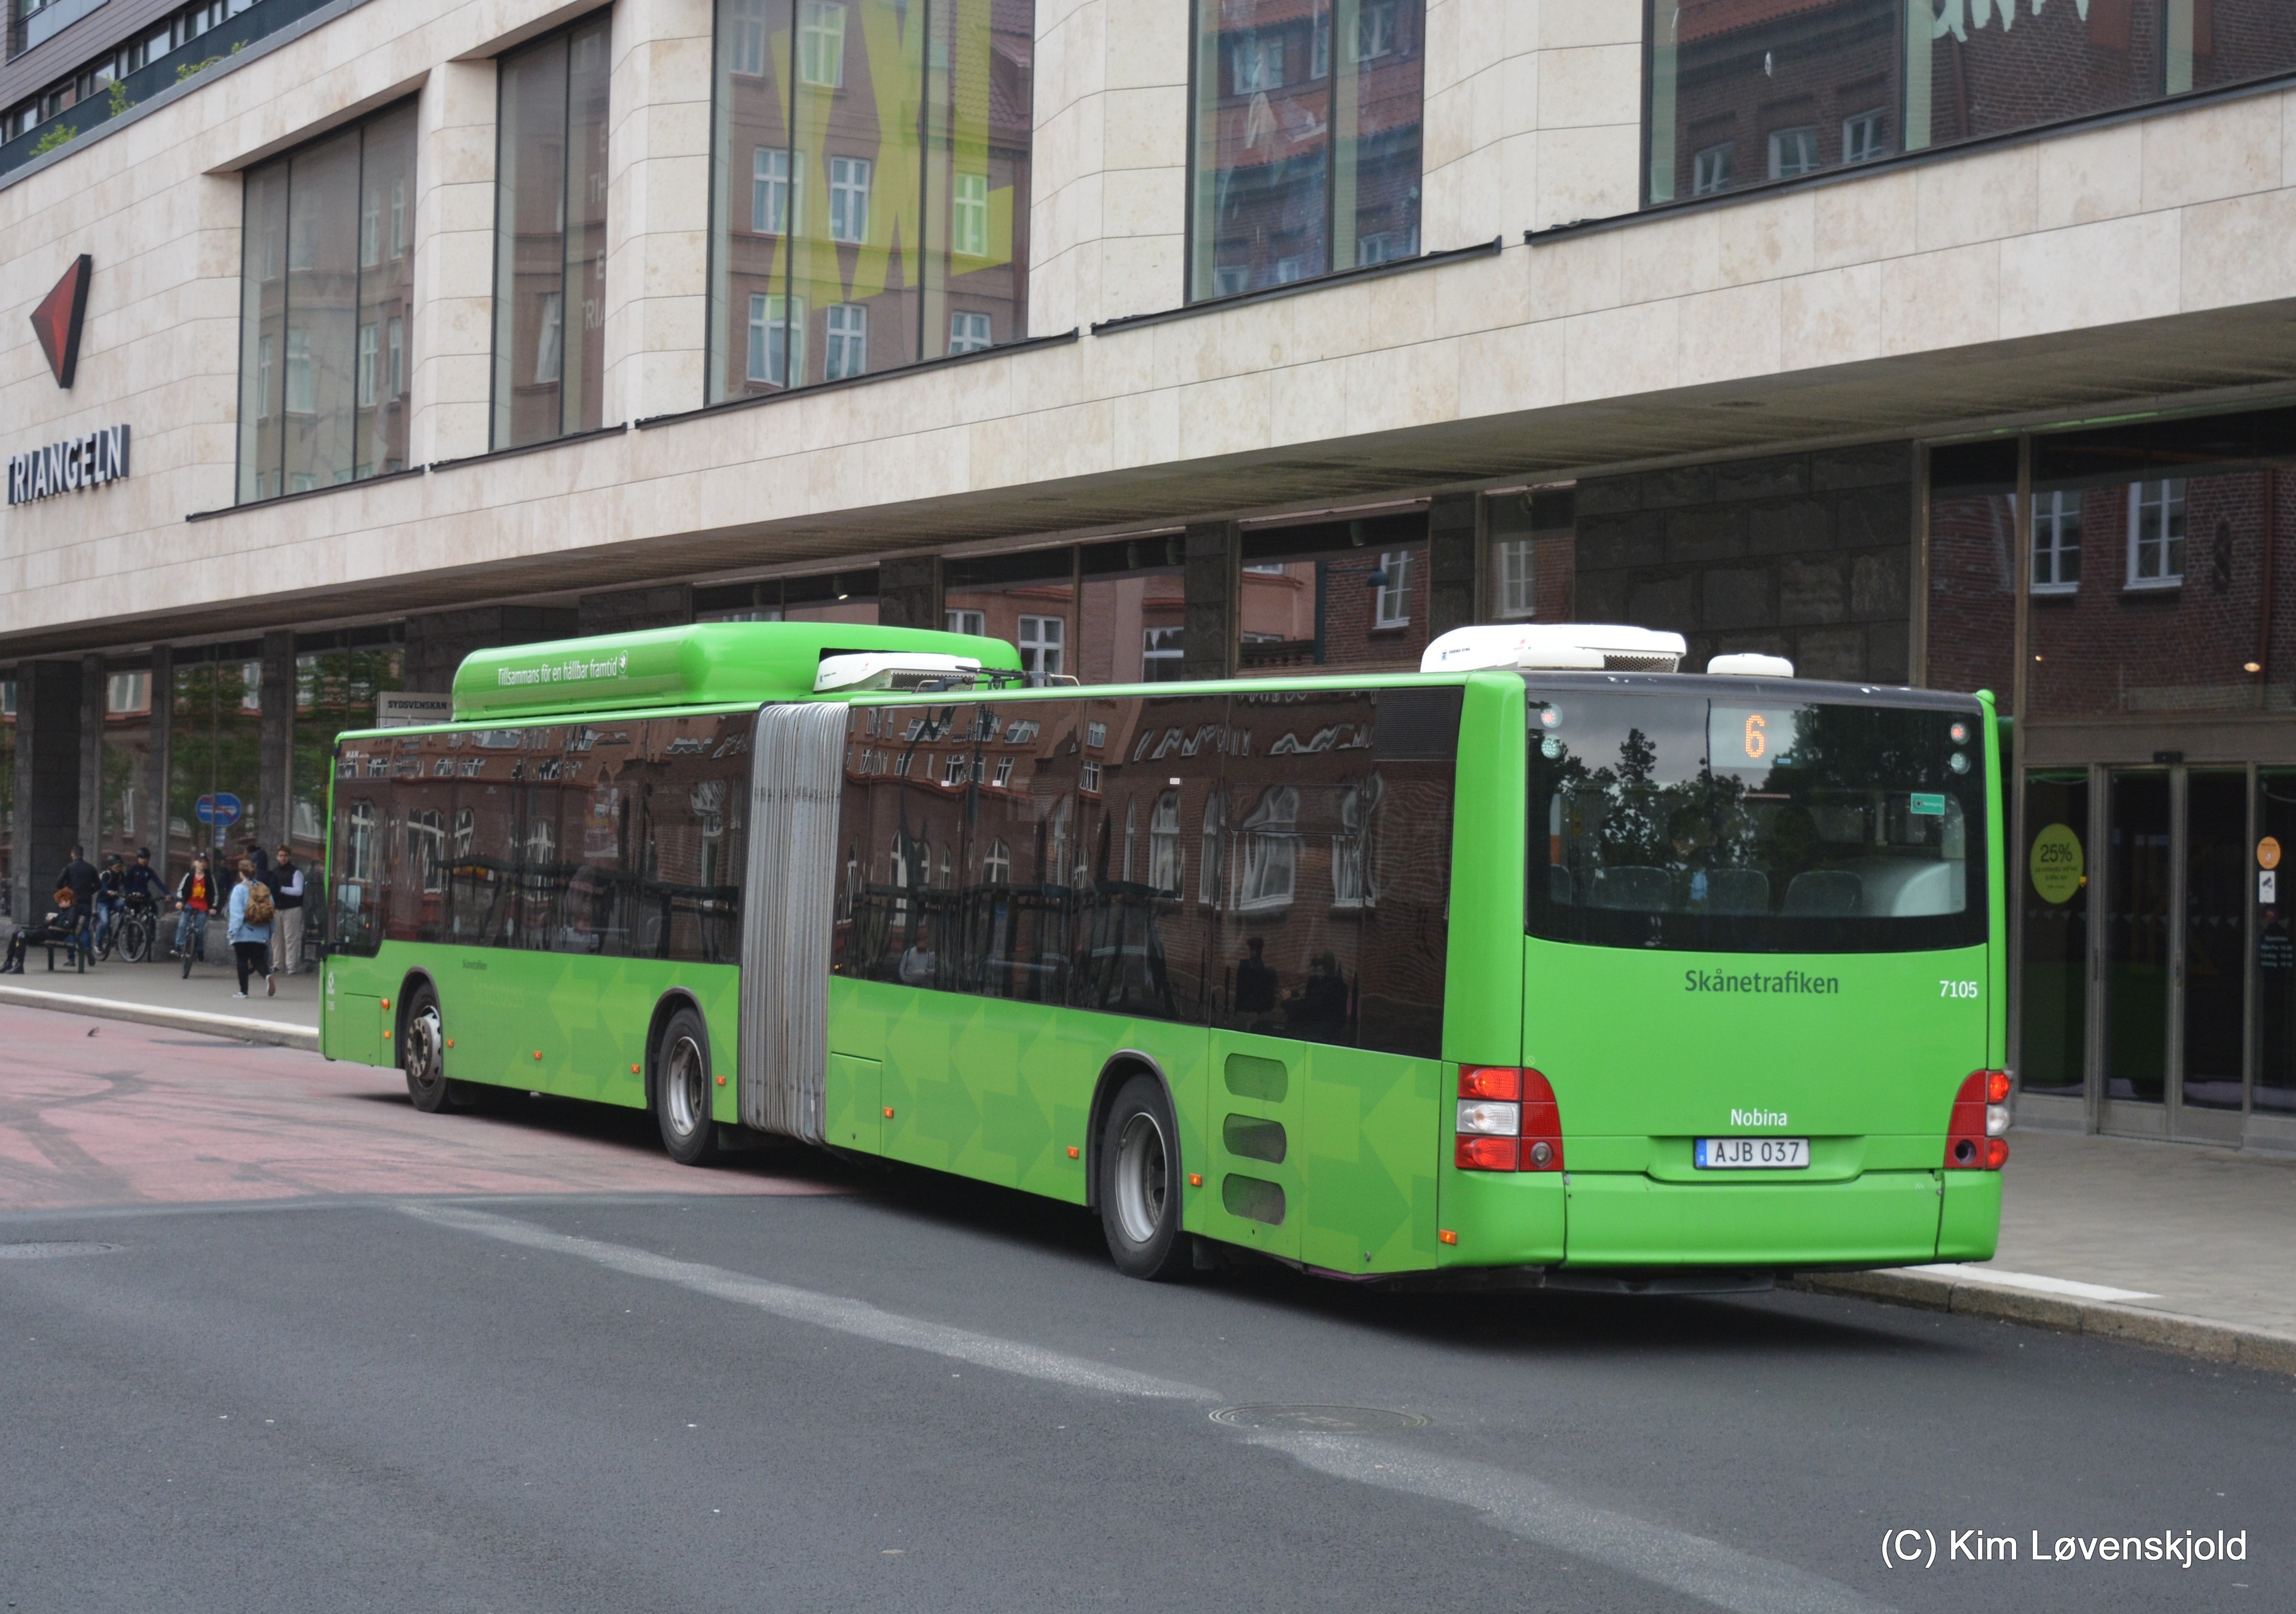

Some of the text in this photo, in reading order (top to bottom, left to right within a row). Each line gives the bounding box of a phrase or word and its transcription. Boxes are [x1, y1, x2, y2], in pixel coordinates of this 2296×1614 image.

[5, 425, 130, 504] TRIANGELN
[498, 656, 618, 686] Tillsammans för en hållbar framtid
[387, 700, 447, 710] SYDSVENSKAN
[1745, 714, 1764, 758] 6
[2040, 843, 2072, 862] 25%
[1684, 968, 1839, 994] Skånetrafiken
[1939, 980, 1978, 998] 7105
[1730, 1108, 1788, 1126] Nobina
[1715, 1142, 1753, 1162] AJB
[1761, 1142, 1800, 1162] 037
